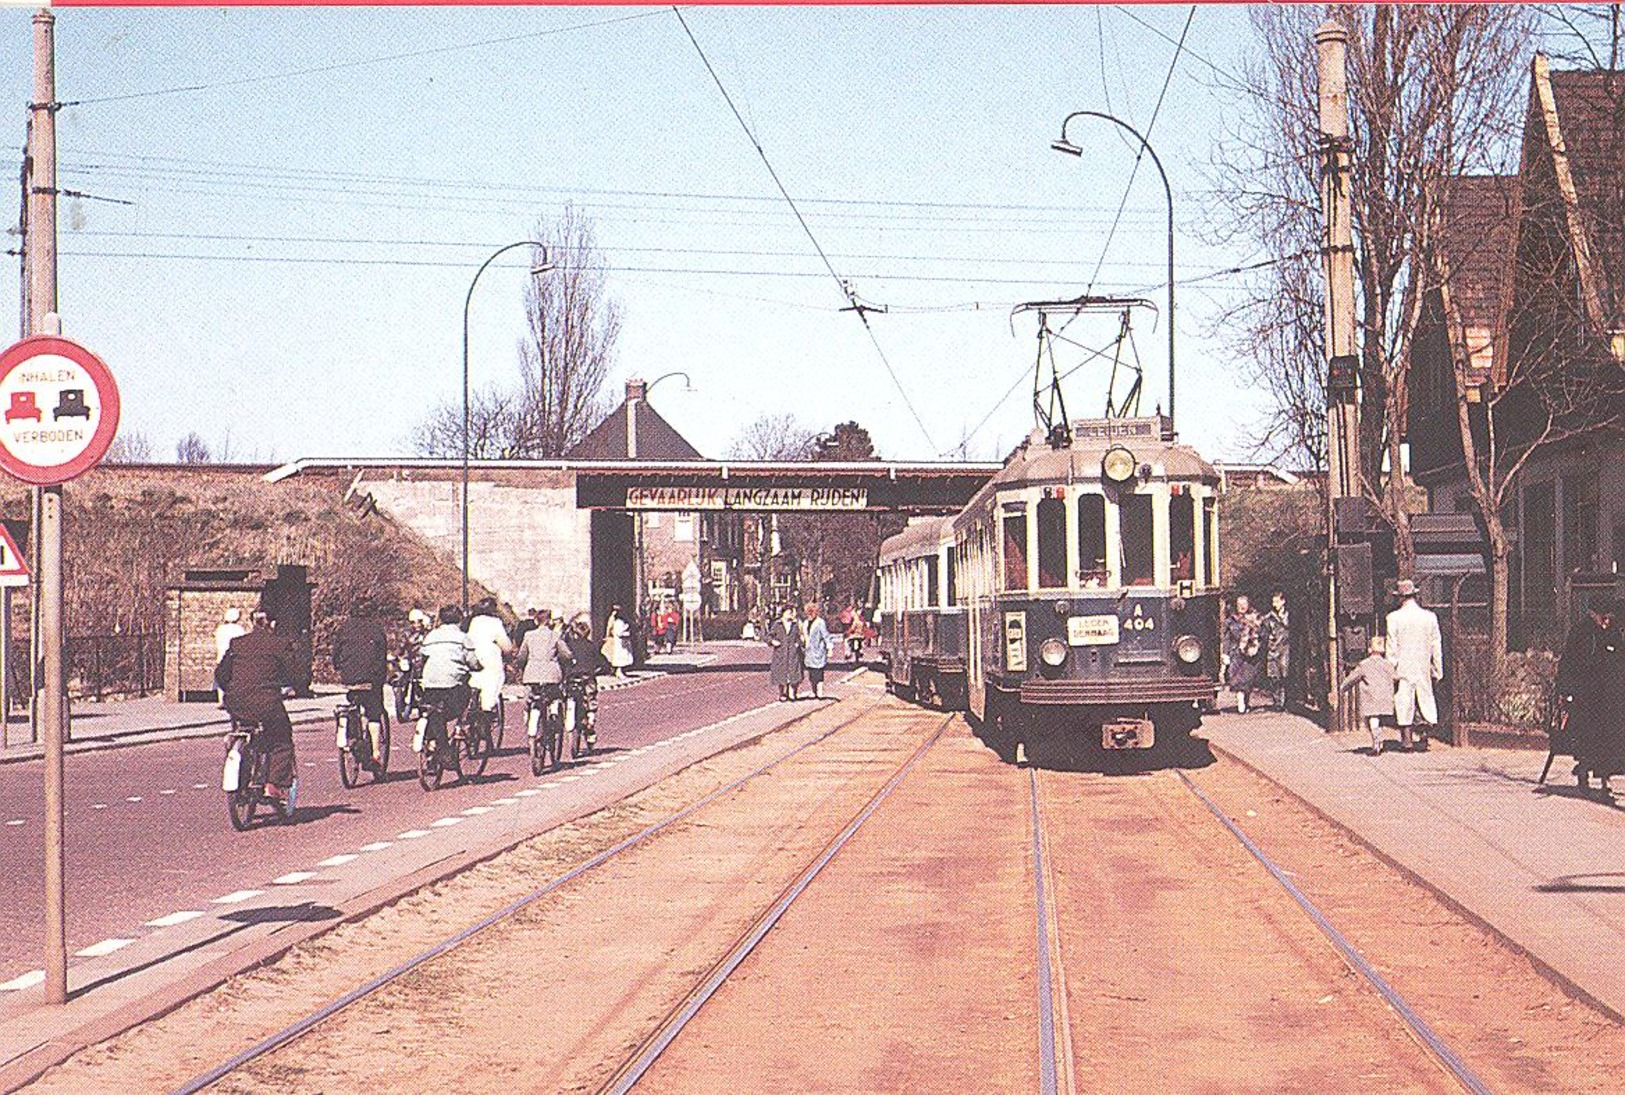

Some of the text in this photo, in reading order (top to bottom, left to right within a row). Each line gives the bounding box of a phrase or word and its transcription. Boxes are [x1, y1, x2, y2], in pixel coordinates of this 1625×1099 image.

[19, 369, 76, 383] INHALEN
[14, 429, 83, 443] VERBODEN
[627, 488, 718, 506] GEVAARLIJK
[724, 488, 802, 506] LANGZAAM
[1179, 581, 1193, 596] H
[1133, 603, 1143, 617] A
[1123, 617, 1154, 631] 404
